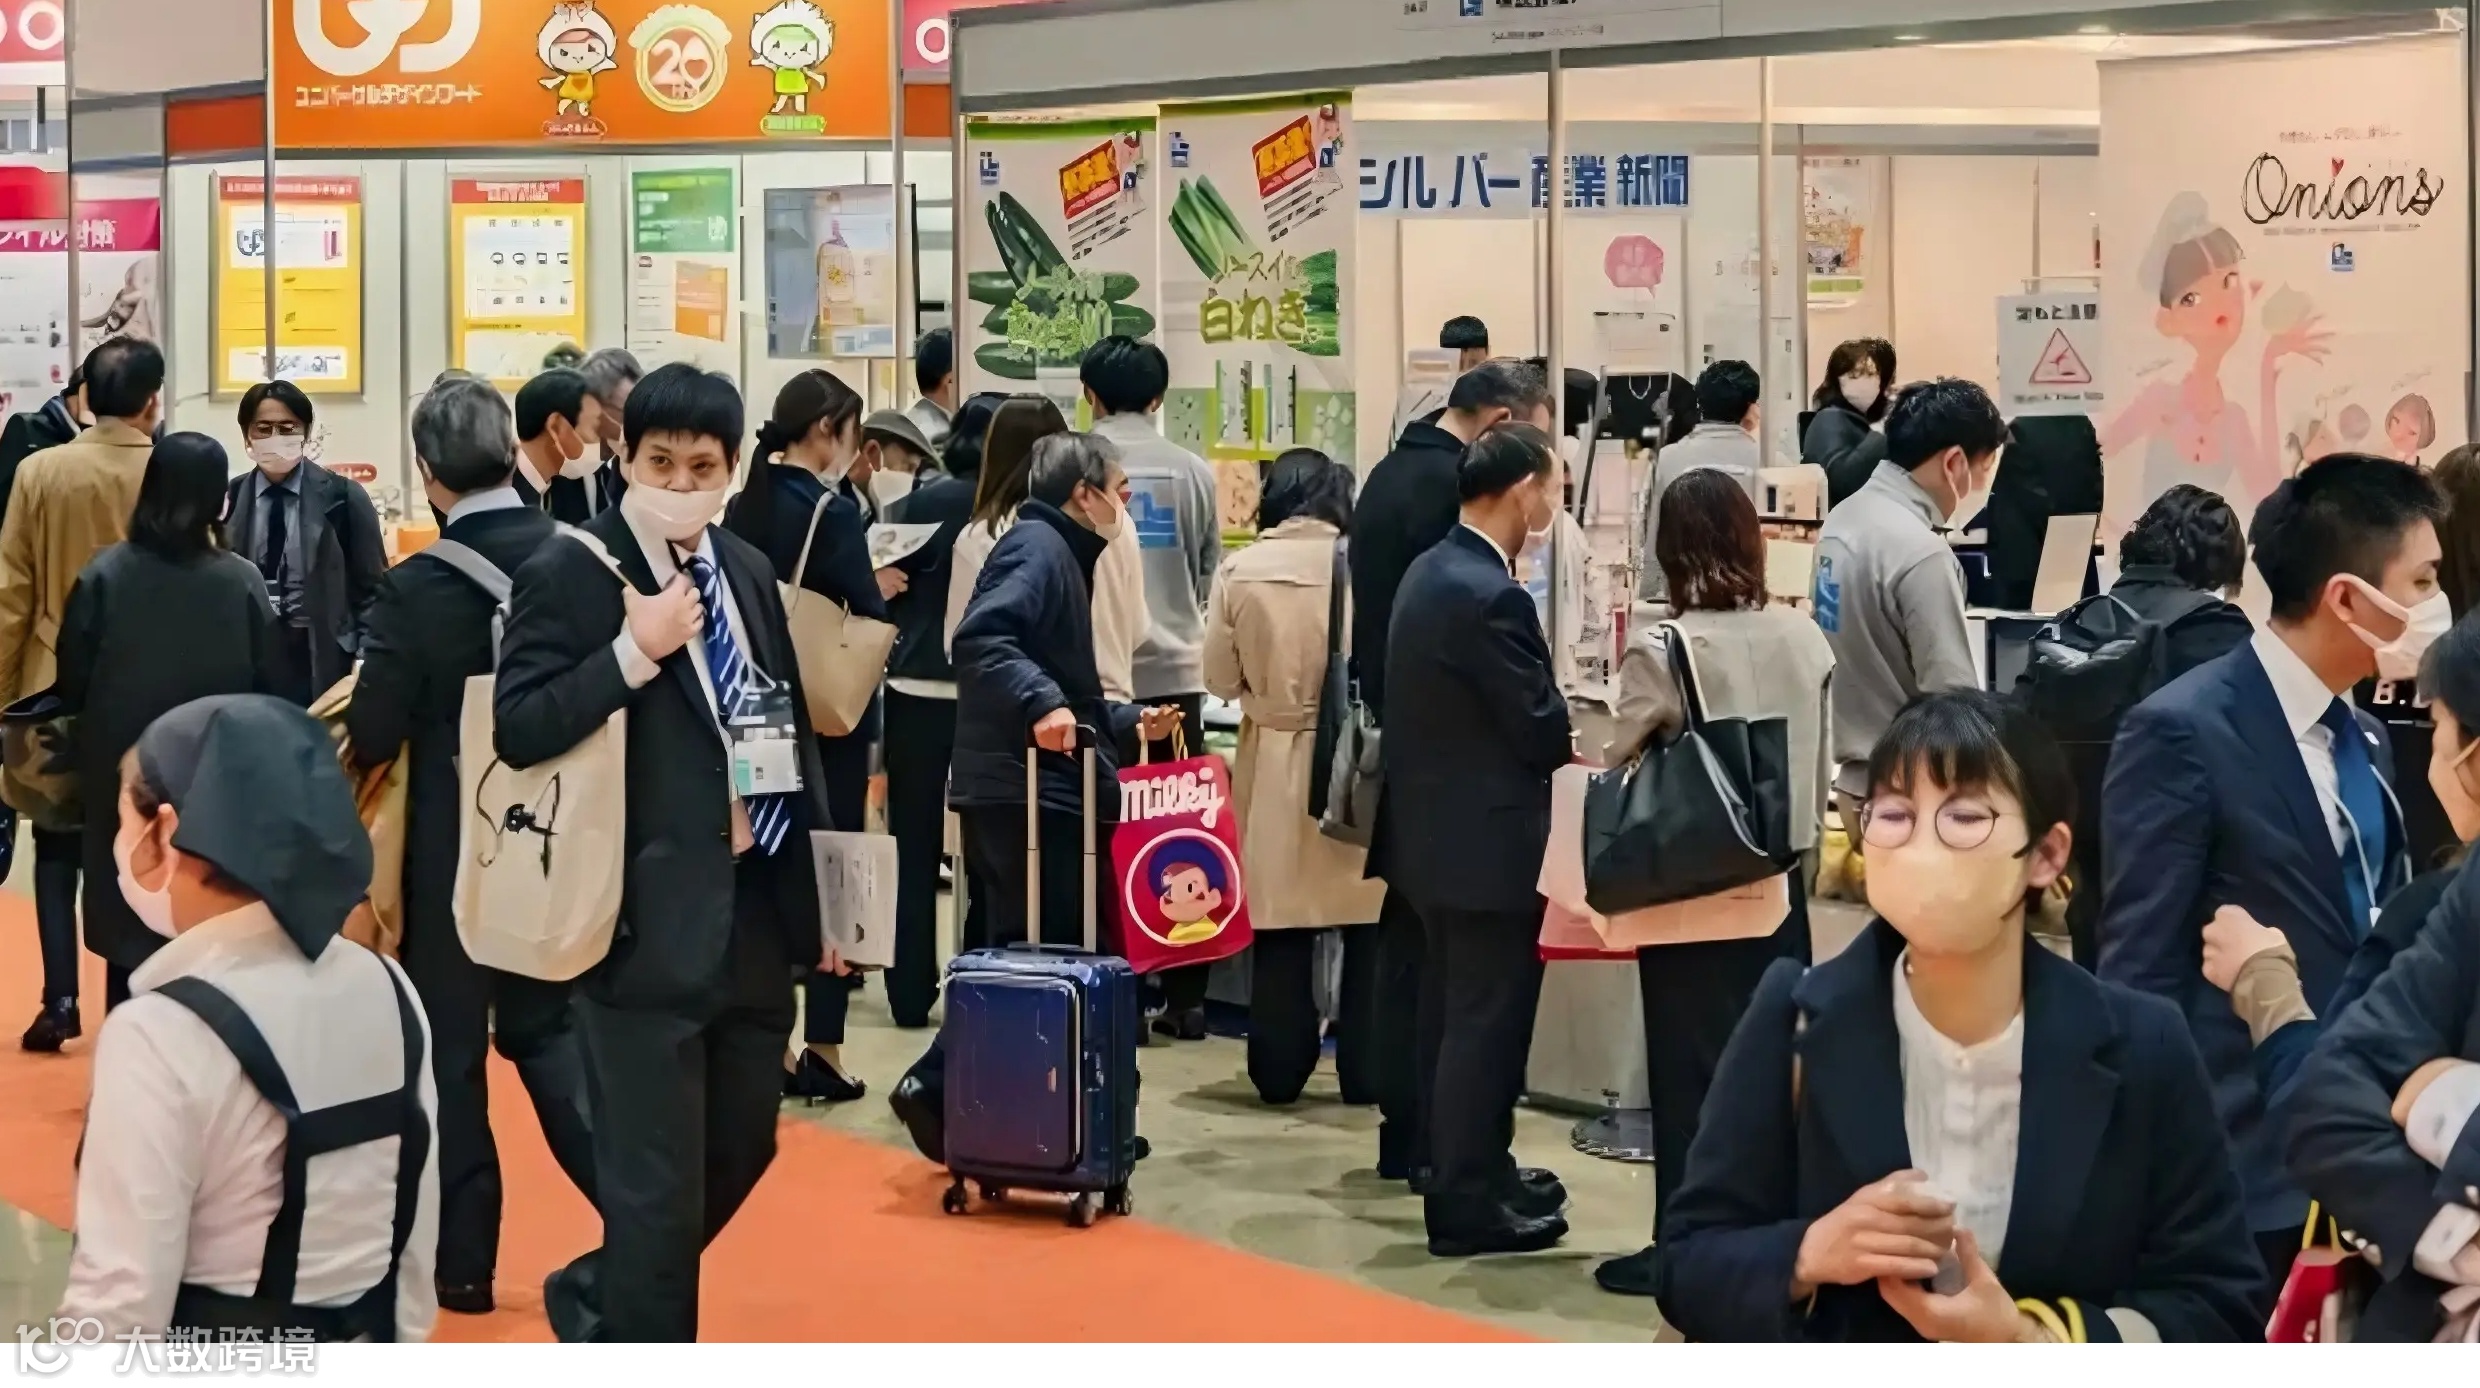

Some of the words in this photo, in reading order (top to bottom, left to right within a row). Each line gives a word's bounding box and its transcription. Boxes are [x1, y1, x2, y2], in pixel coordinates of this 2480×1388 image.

[2240, 151, 2445, 225] Onions
[1200, 288, 1307, 343] 白ねぎ
[1119, 767, 1226, 829] Milky
